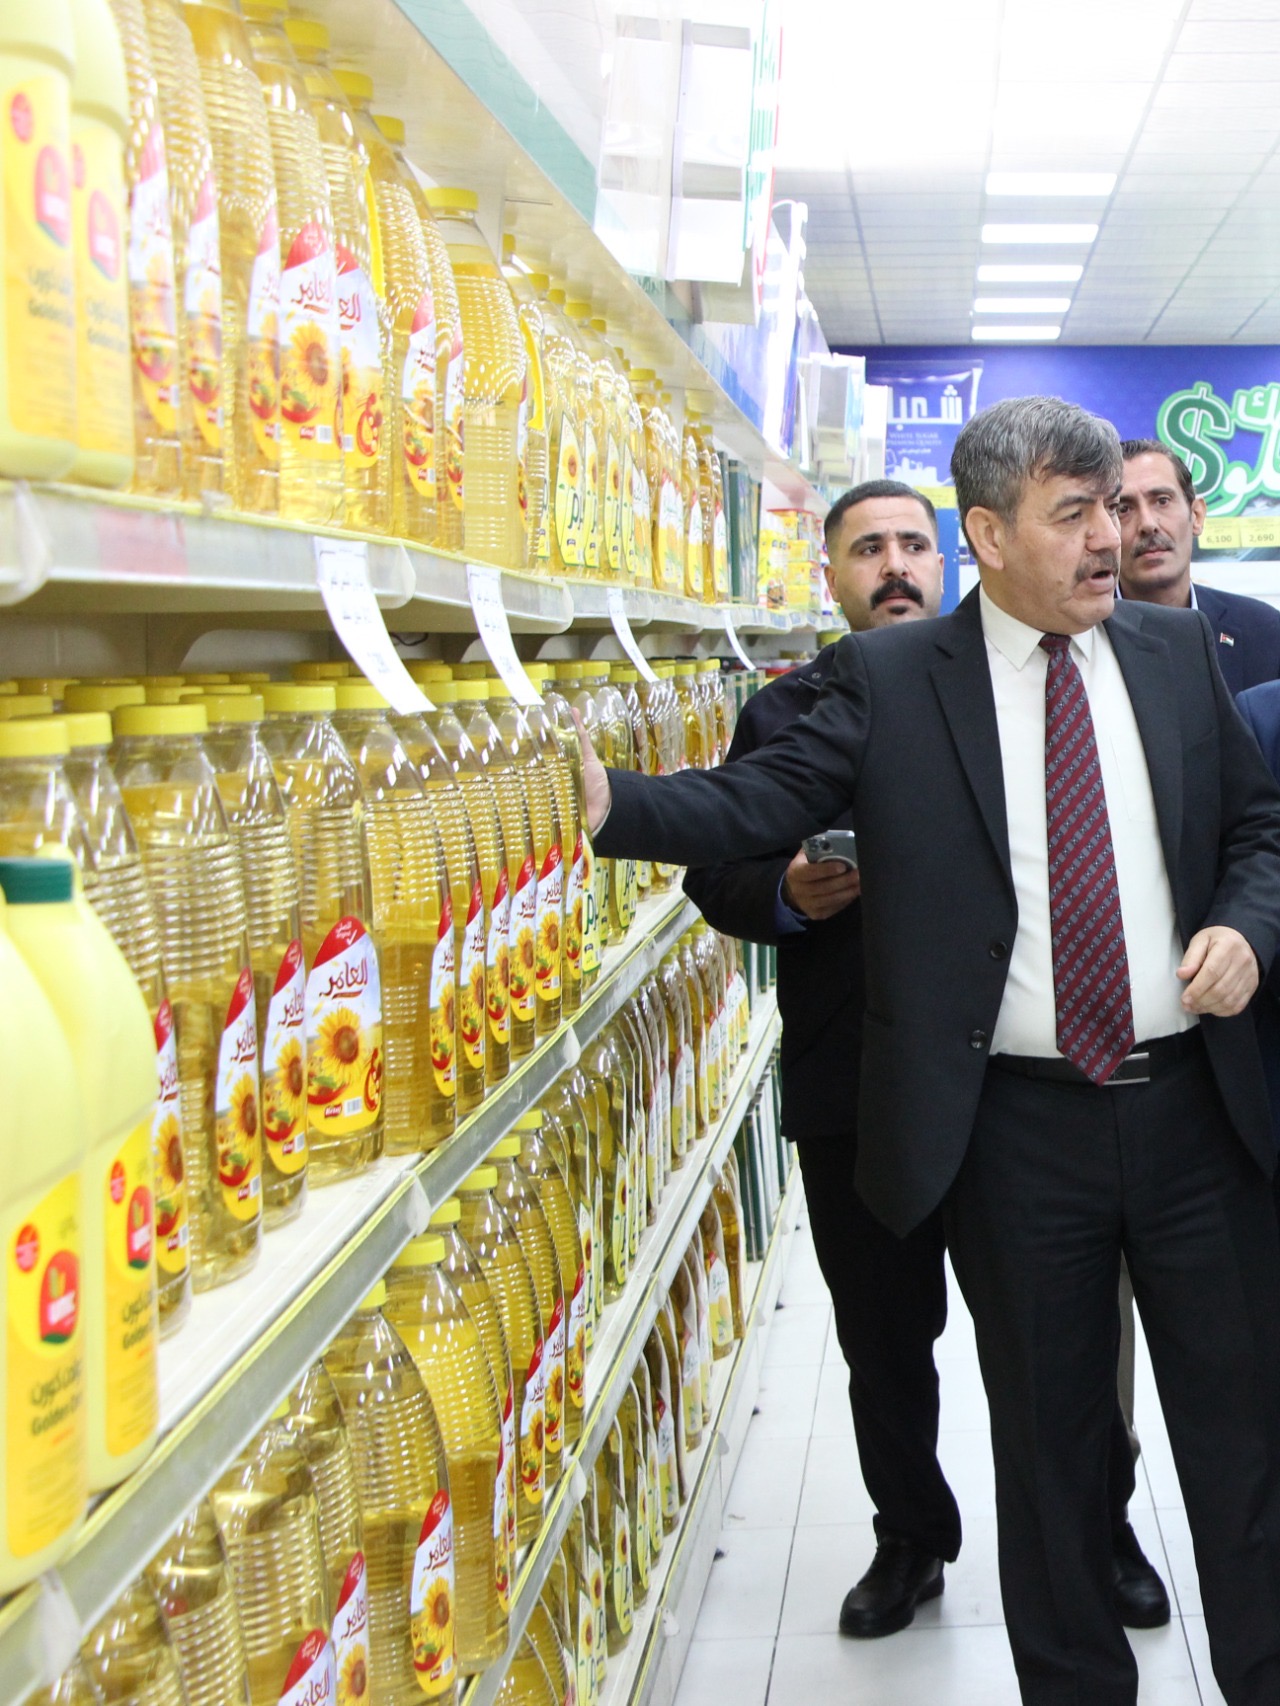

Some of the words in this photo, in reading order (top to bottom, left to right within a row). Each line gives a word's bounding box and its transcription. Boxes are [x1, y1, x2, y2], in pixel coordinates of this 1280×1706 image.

[887, 384, 963, 431] شعبا
[1206, 534, 1232, 543] 6,100
[1249, 533, 1275, 543] 2,690
[319, 956, 368, 998] العامر
